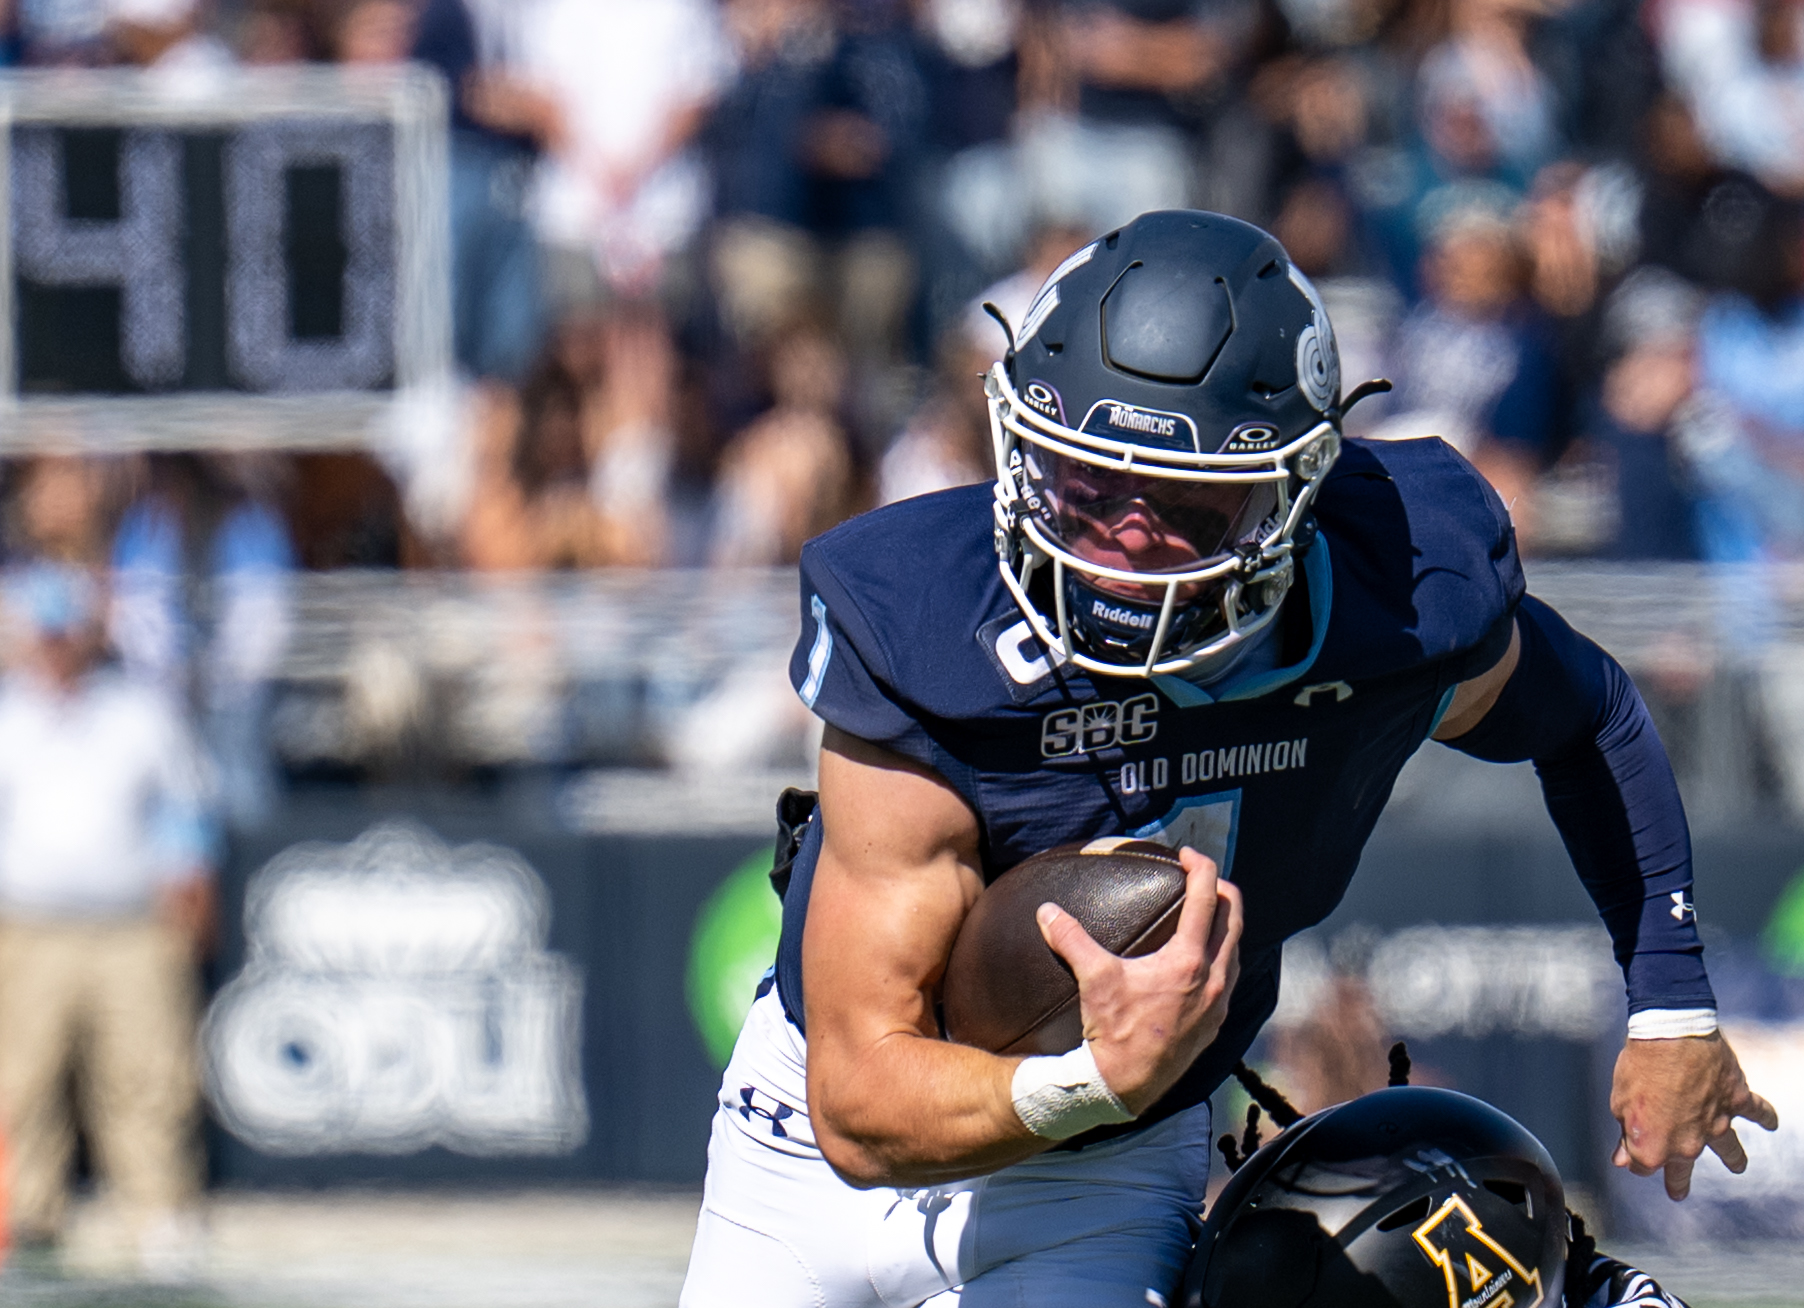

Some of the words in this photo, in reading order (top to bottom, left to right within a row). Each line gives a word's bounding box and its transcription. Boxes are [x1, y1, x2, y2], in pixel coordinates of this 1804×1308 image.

[13, 120, 394, 392] 40
[1109, 406, 1176, 436] MONARCHS
[1229, 441, 1276, 450] OAKLEY
[1092, 600, 1153, 629] Riddell
[1120, 758, 1168, 794] OLD
[1182, 738, 1308, 786] DOMINION
